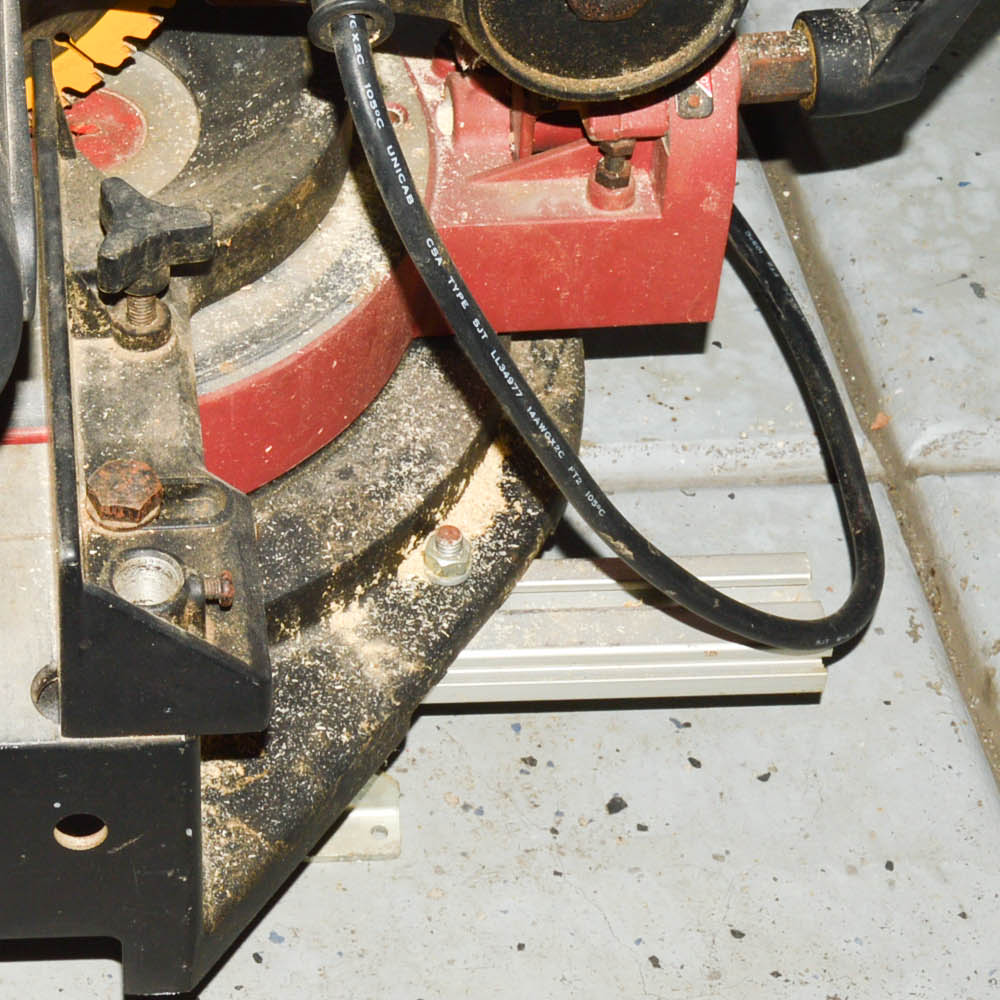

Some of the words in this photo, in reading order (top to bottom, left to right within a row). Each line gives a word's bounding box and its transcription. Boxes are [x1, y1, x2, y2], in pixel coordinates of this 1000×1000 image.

[387, 145, 414, 205] UNICAB
[426, 238, 443, 266] CSA
[448, 276, 469, 309] TYPE
[472, 318, 488, 340] SJT
[490, 350, 523, 397] LL34977
[568, 466, 582, 485] FT2
